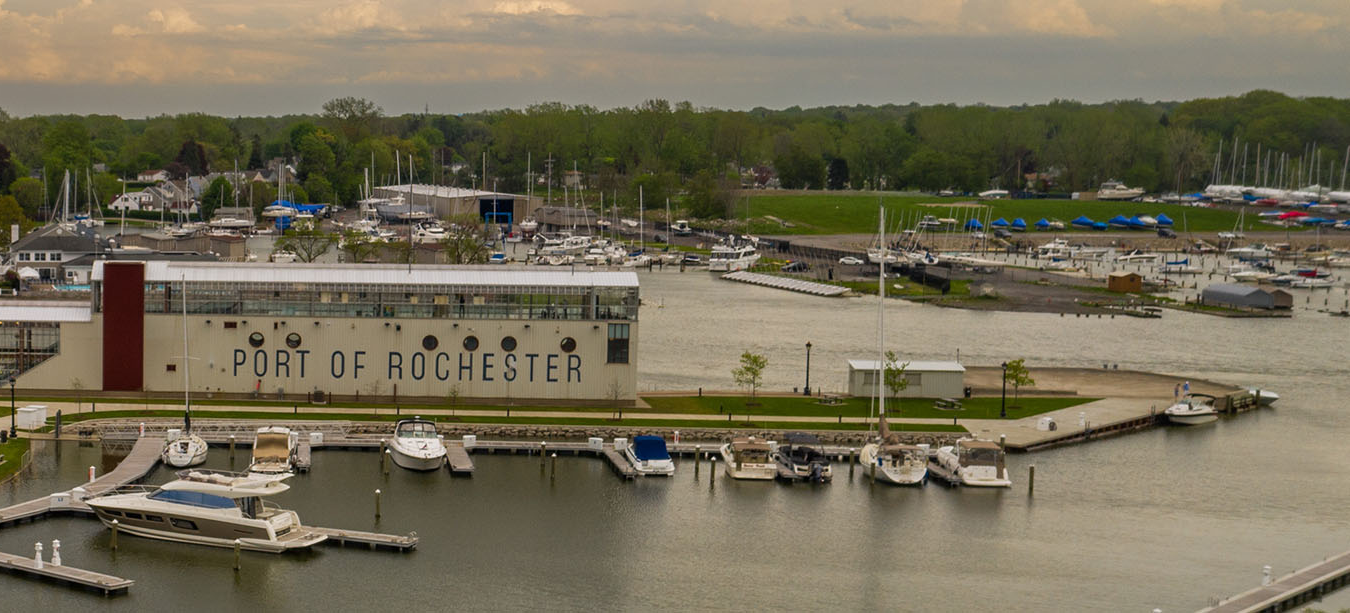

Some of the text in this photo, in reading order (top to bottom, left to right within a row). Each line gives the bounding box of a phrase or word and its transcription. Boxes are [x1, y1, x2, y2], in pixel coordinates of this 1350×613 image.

[233, 349, 582, 382] PORT OF ROCHESTER
